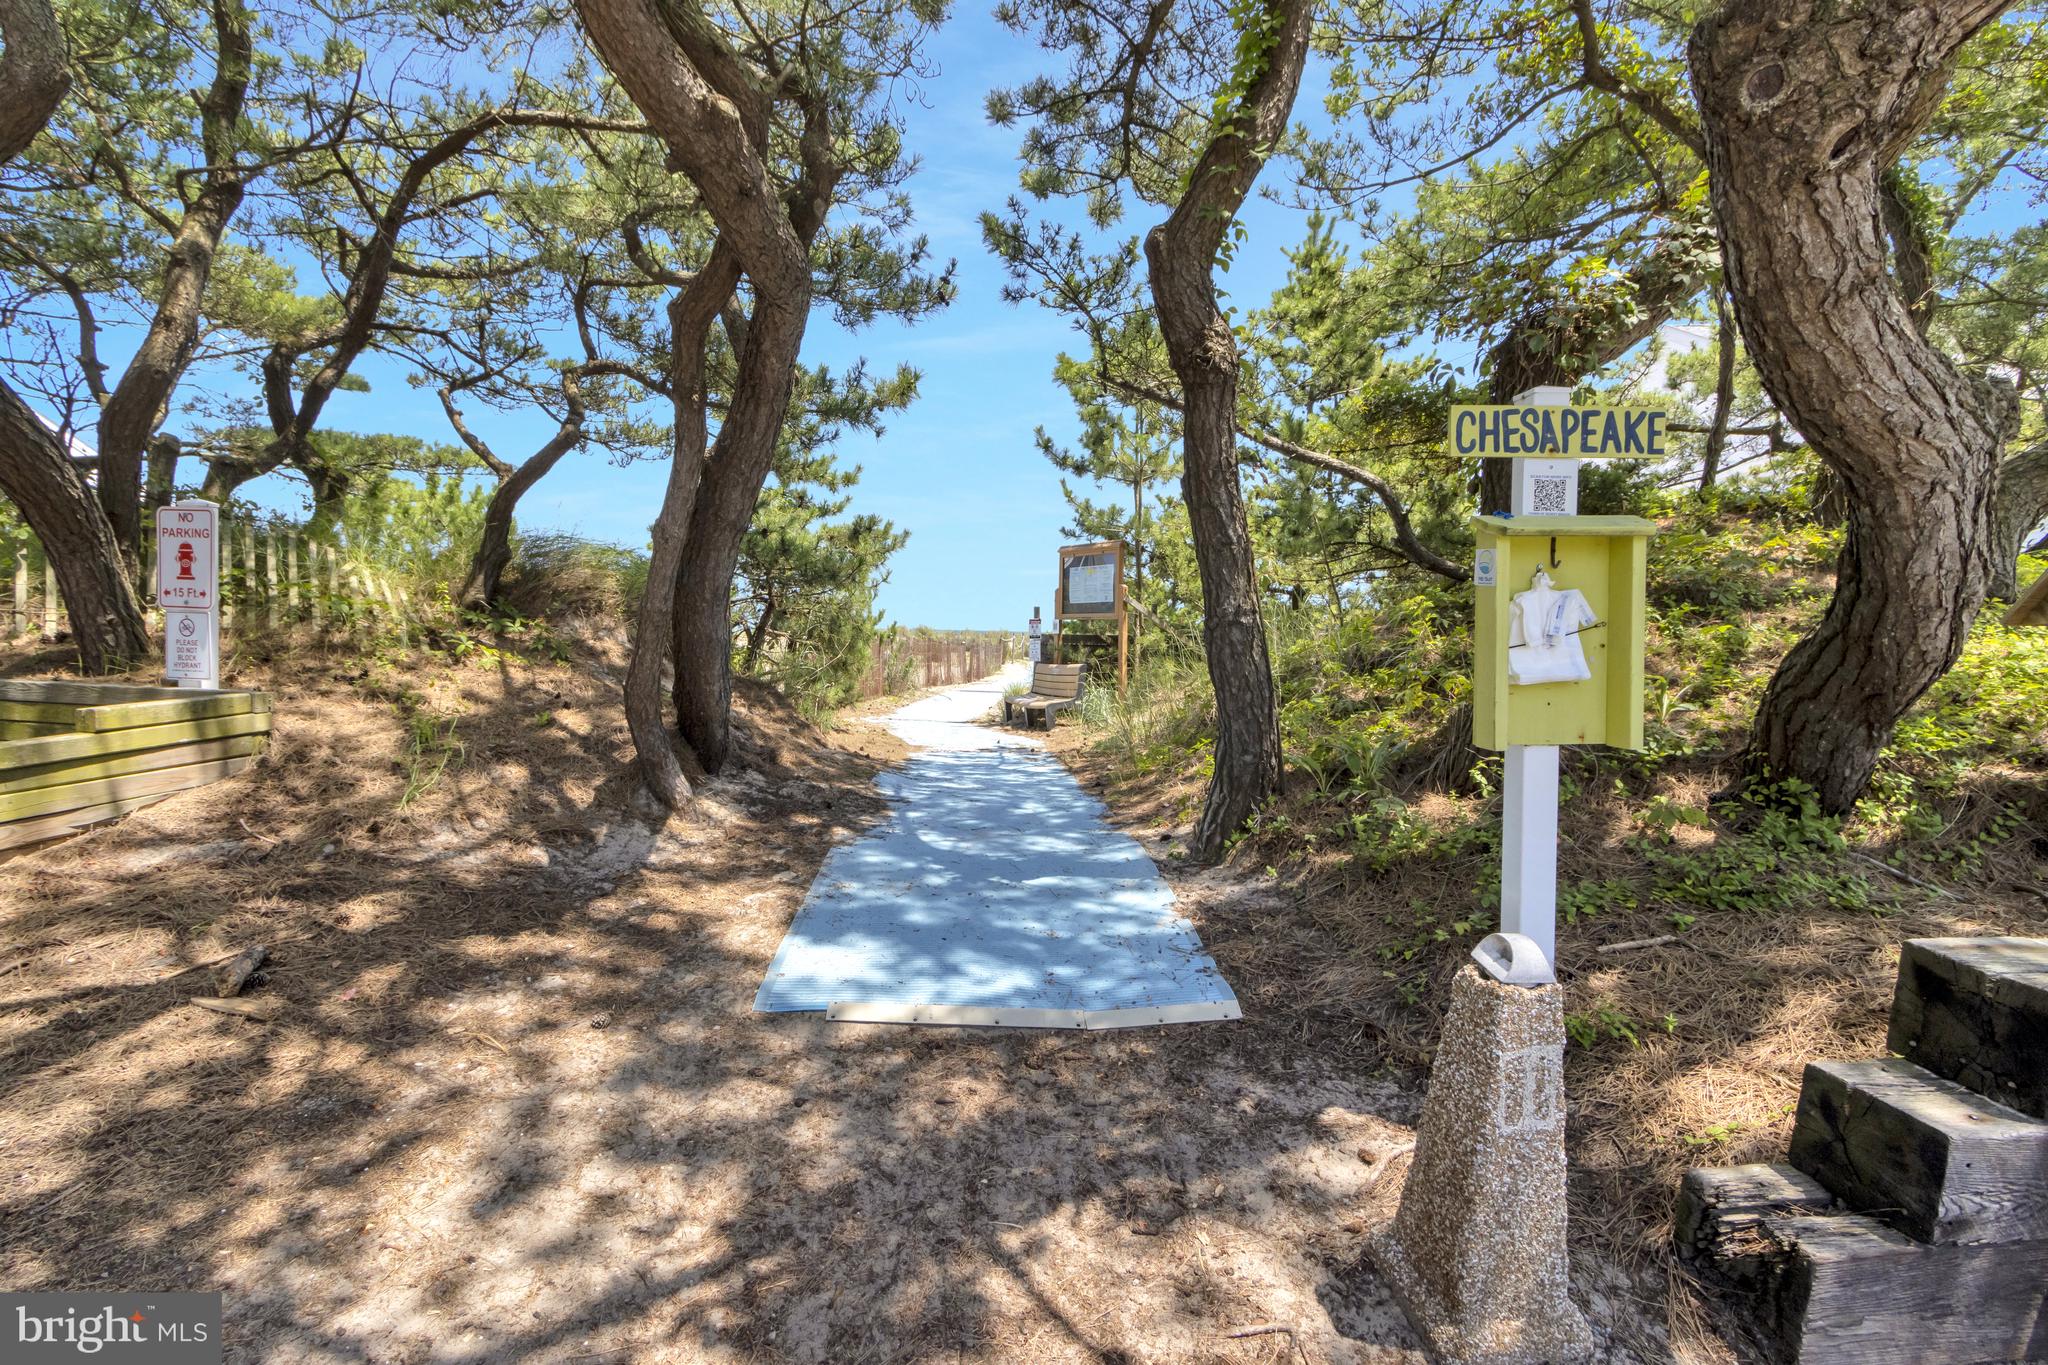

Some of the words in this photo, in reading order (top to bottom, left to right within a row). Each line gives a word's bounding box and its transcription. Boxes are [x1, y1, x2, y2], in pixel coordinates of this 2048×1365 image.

[1456, 407, 1666, 455] CHESAPEAKE
[178, 512, 194, 522] NO
[162, 527, 210, 538] PARKING
[173, 587, 184, 597] 15
